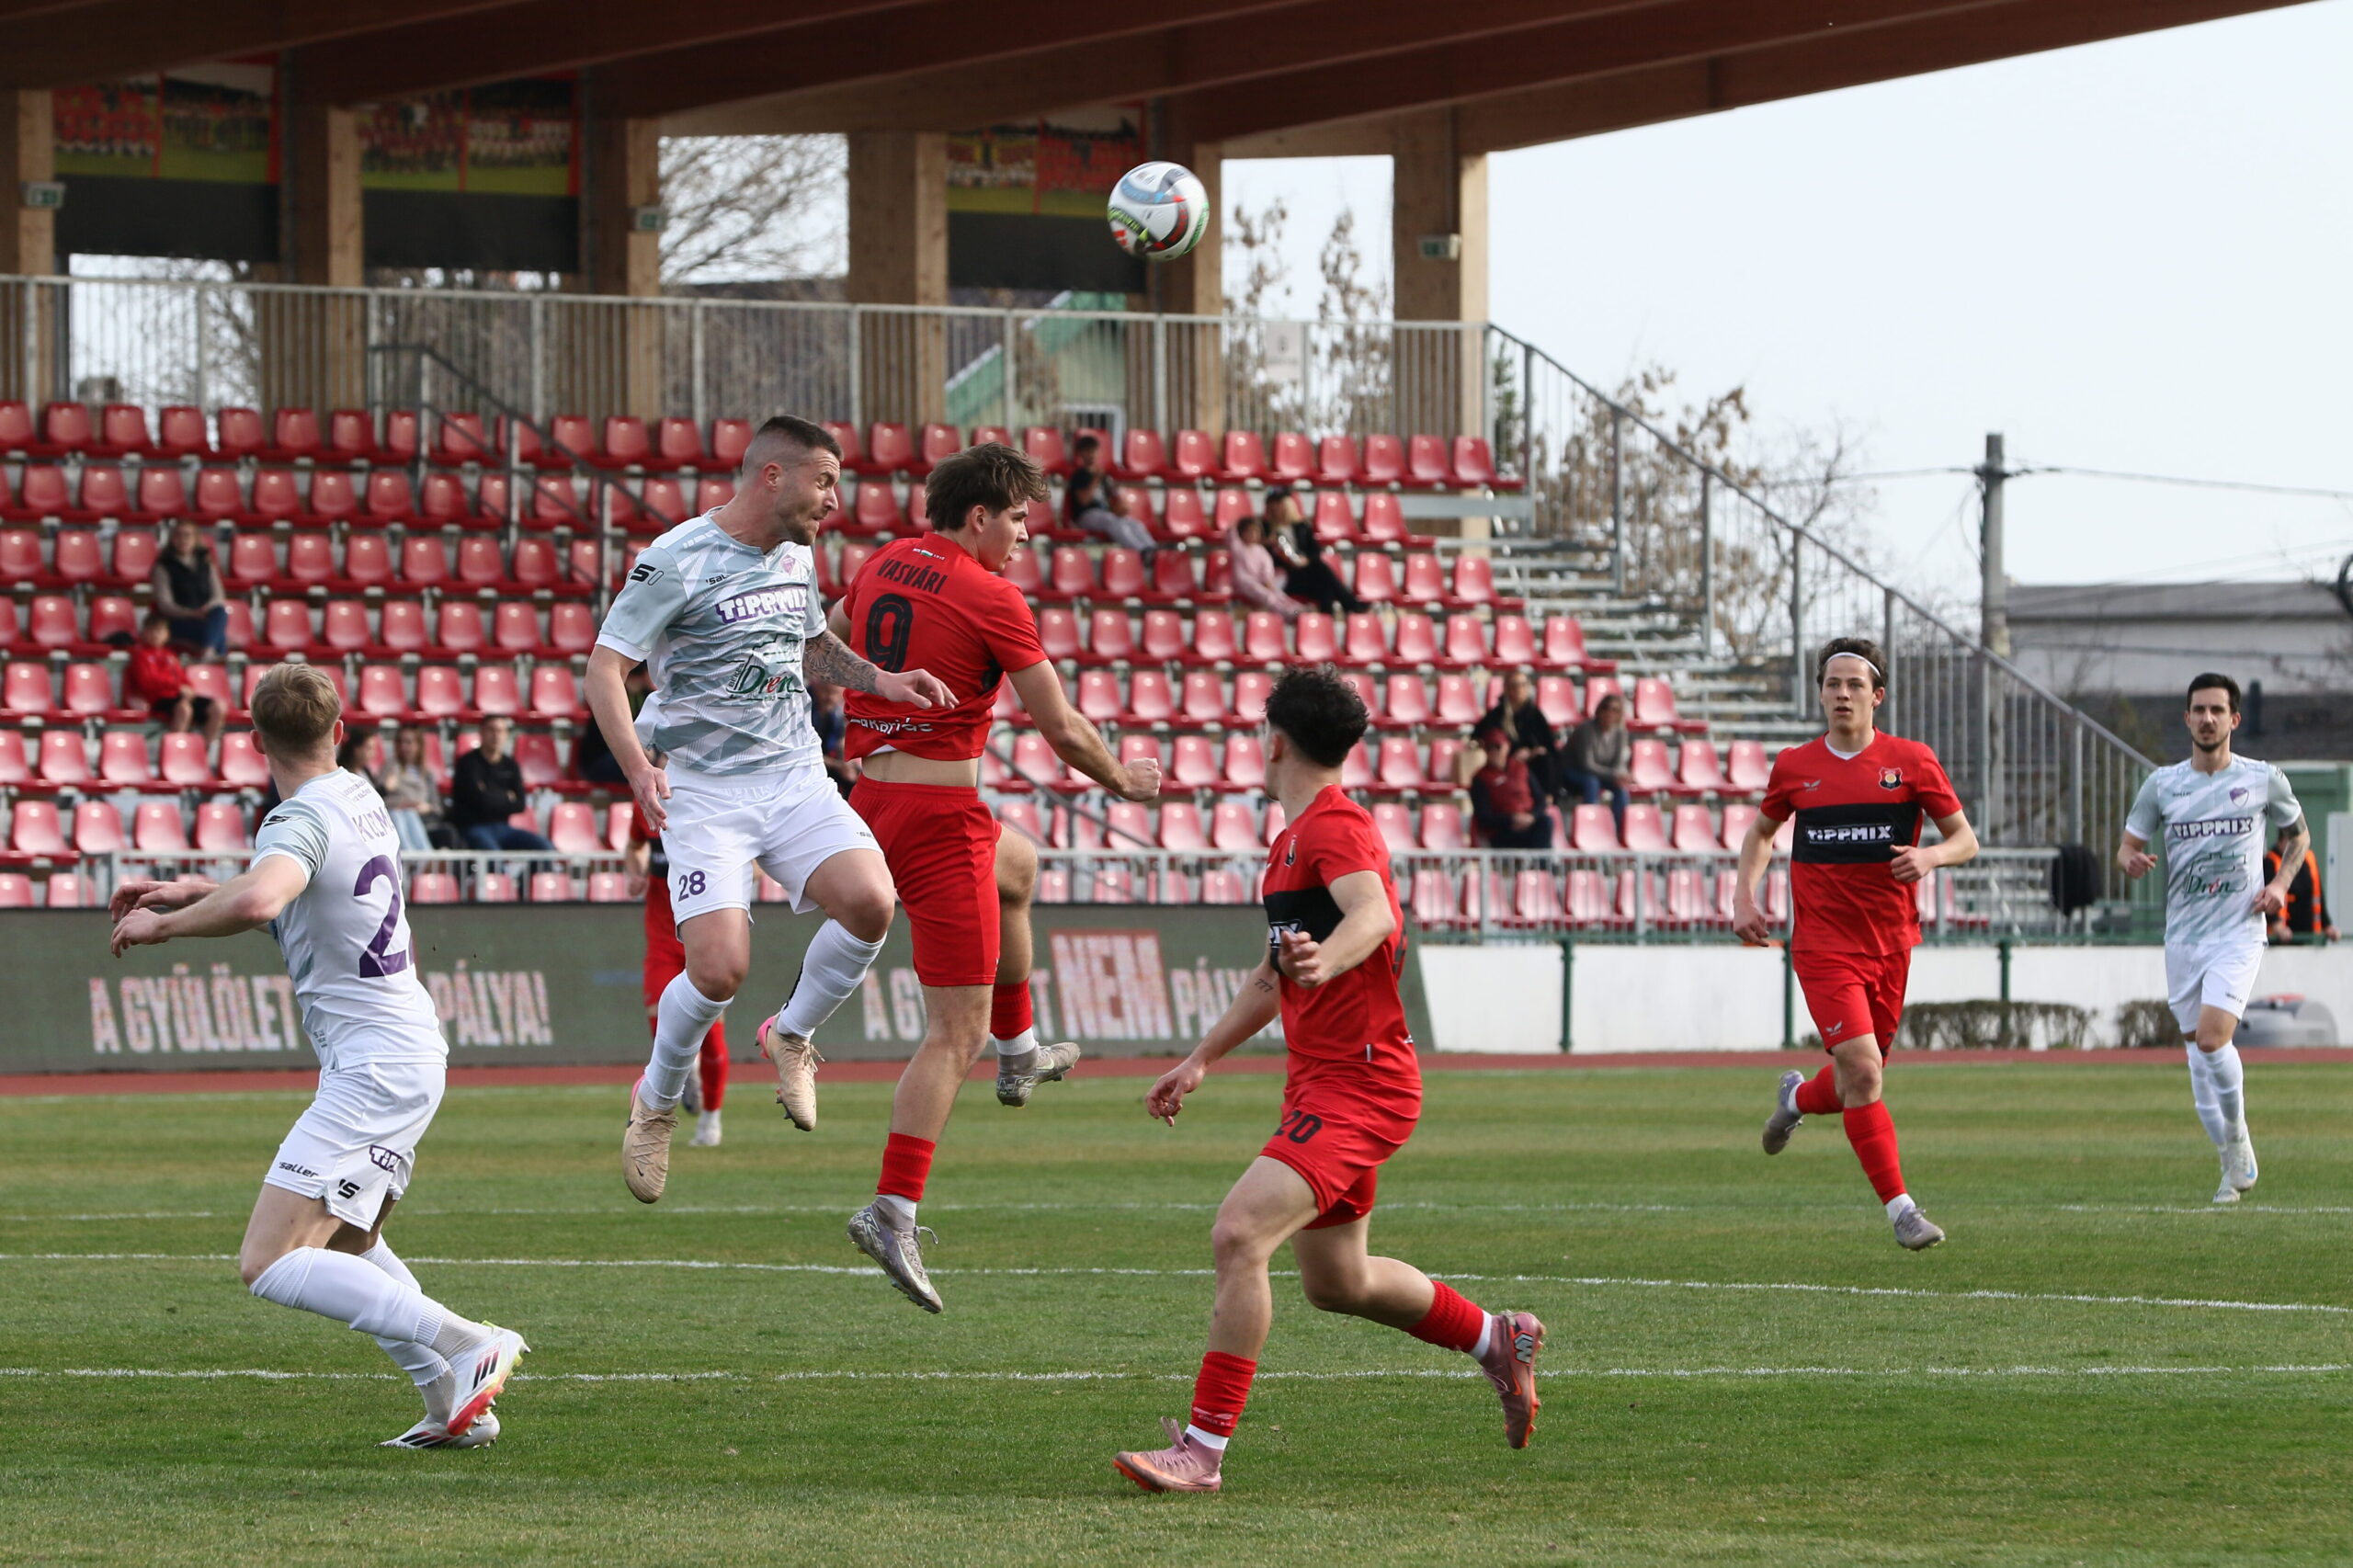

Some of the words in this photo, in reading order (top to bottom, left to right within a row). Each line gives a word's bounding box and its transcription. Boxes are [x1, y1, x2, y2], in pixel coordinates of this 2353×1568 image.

[876, 559, 947, 595] VASVÁRI
[866, 593, 913, 673] 9
[678, 870, 706, 902] 28
[89, 977, 120, 1053] A
[426, 959, 553, 1046] PÁLYA!
[1051, 935, 1173, 1040] NEM
